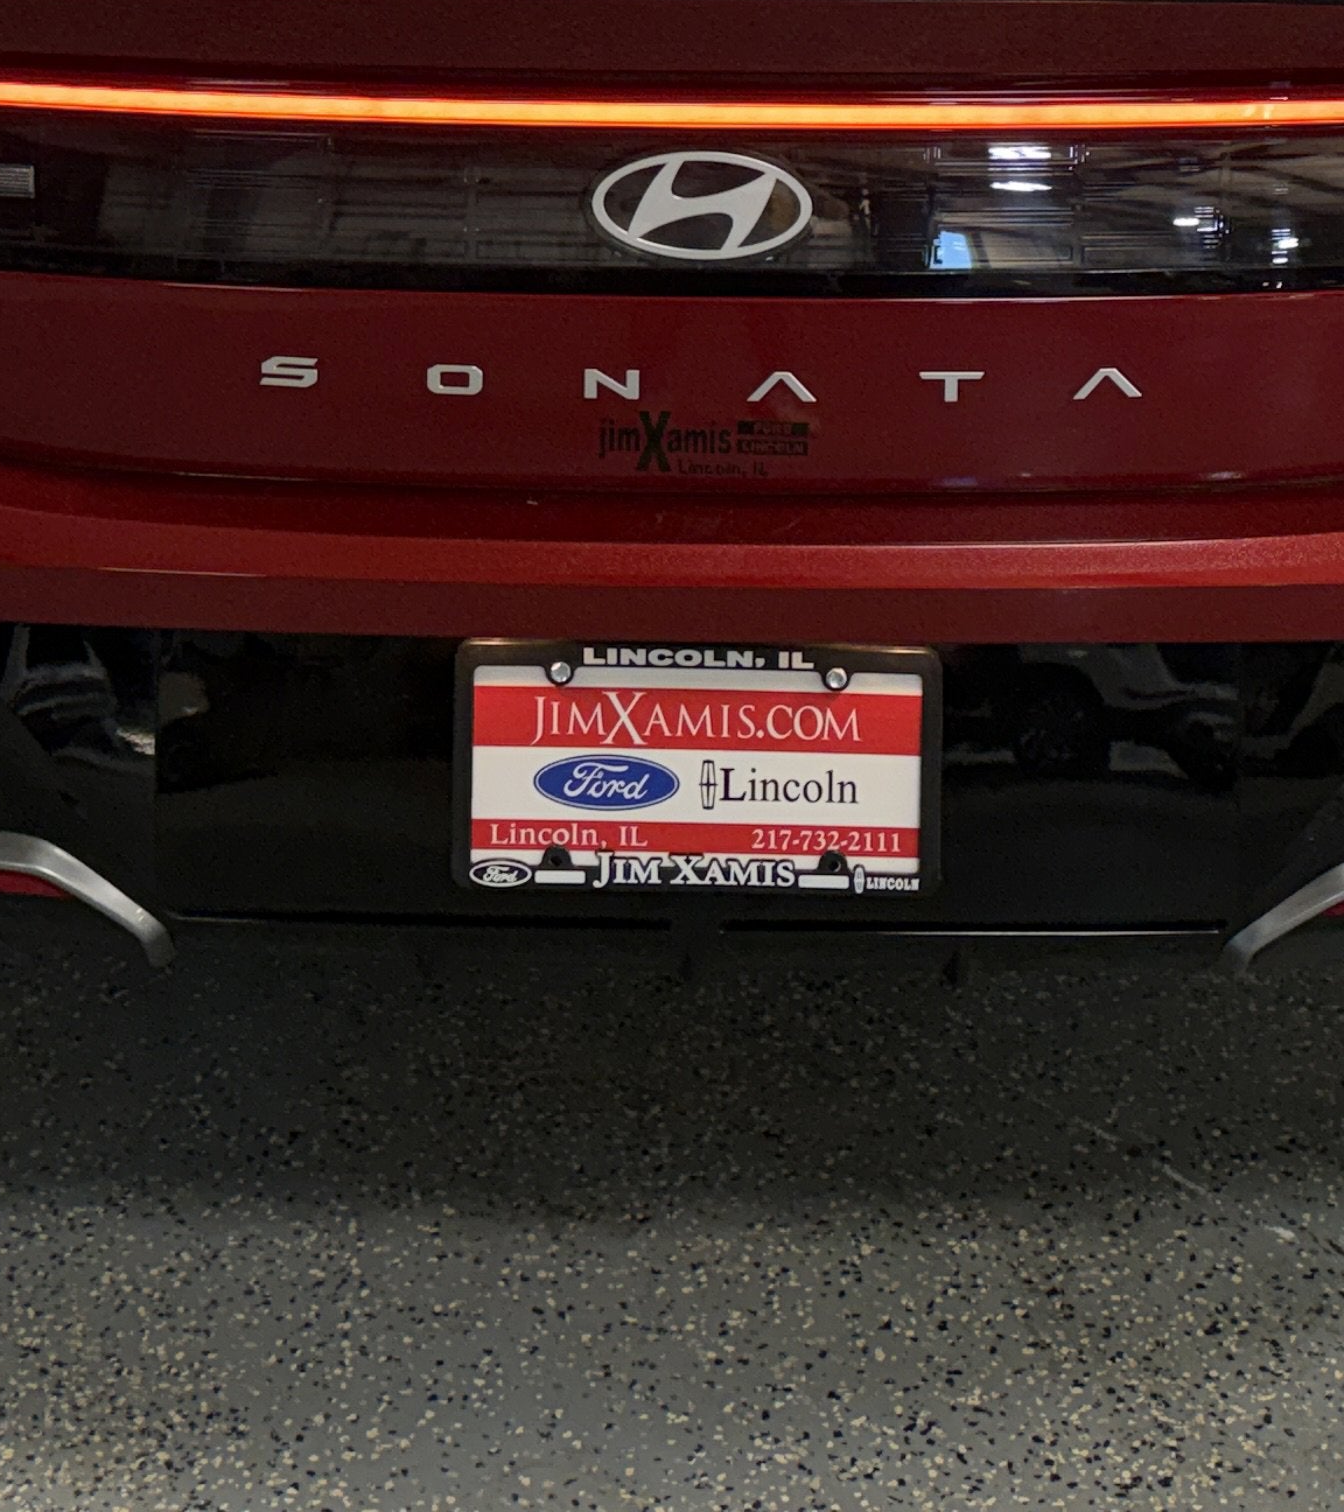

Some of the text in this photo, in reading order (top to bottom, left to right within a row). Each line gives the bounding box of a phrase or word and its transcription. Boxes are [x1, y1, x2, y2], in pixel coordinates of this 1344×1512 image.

[259, 355, 1143, 403] SONATA
[582, 646, 815, 670] LINCOLN, IL
[529, 690, 862, 746] JIMXAMIS.COM
[563, 762, 650, 802] Ford
[719, 767, 859, 804] Lincoln
[490, 822, 648, 849] Lincoln, IL
[751, 828, 902, 854] 217-732-2111
[481, 866, 519, 885] Ford
[592, 851, 797, 889] JIM XAMIS
[865, 877, 921, 892] LINCOLN
